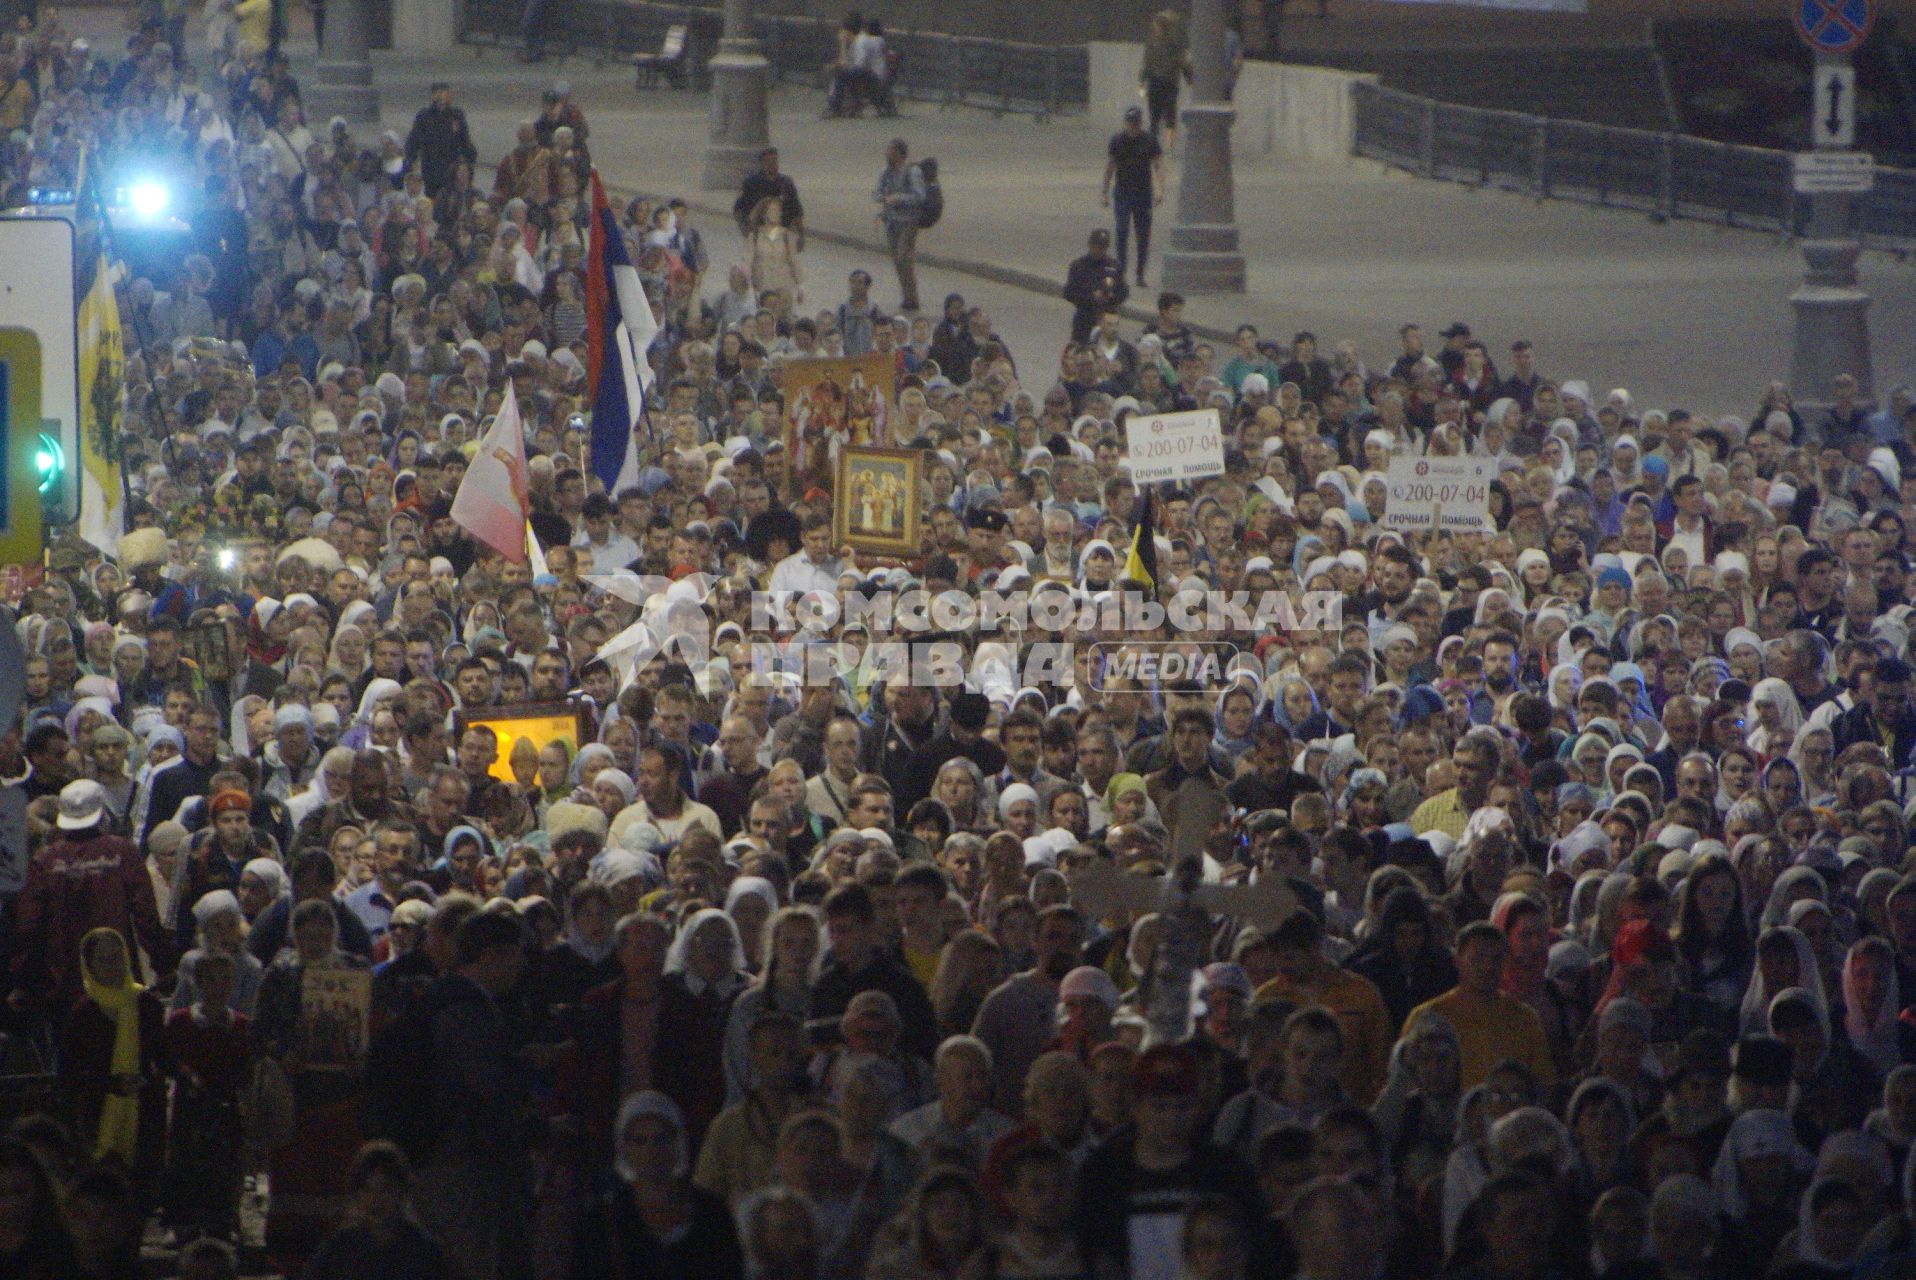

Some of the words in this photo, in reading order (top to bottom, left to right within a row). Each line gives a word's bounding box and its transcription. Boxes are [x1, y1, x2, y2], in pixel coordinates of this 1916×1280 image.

[1147, 434, 1218, 457] 200-07-04
[1135, 466, 1173, 479] СРОЧНАЯ
[1183, 461, 1222, 473] ПОМОЩЬ
[1405, 484, 1485, 502] 200-07-04
[1388, 514, 1430, 525] СРОЧНАЯ
[1441, 514, 1483, 527] ПОМОЩЬ
